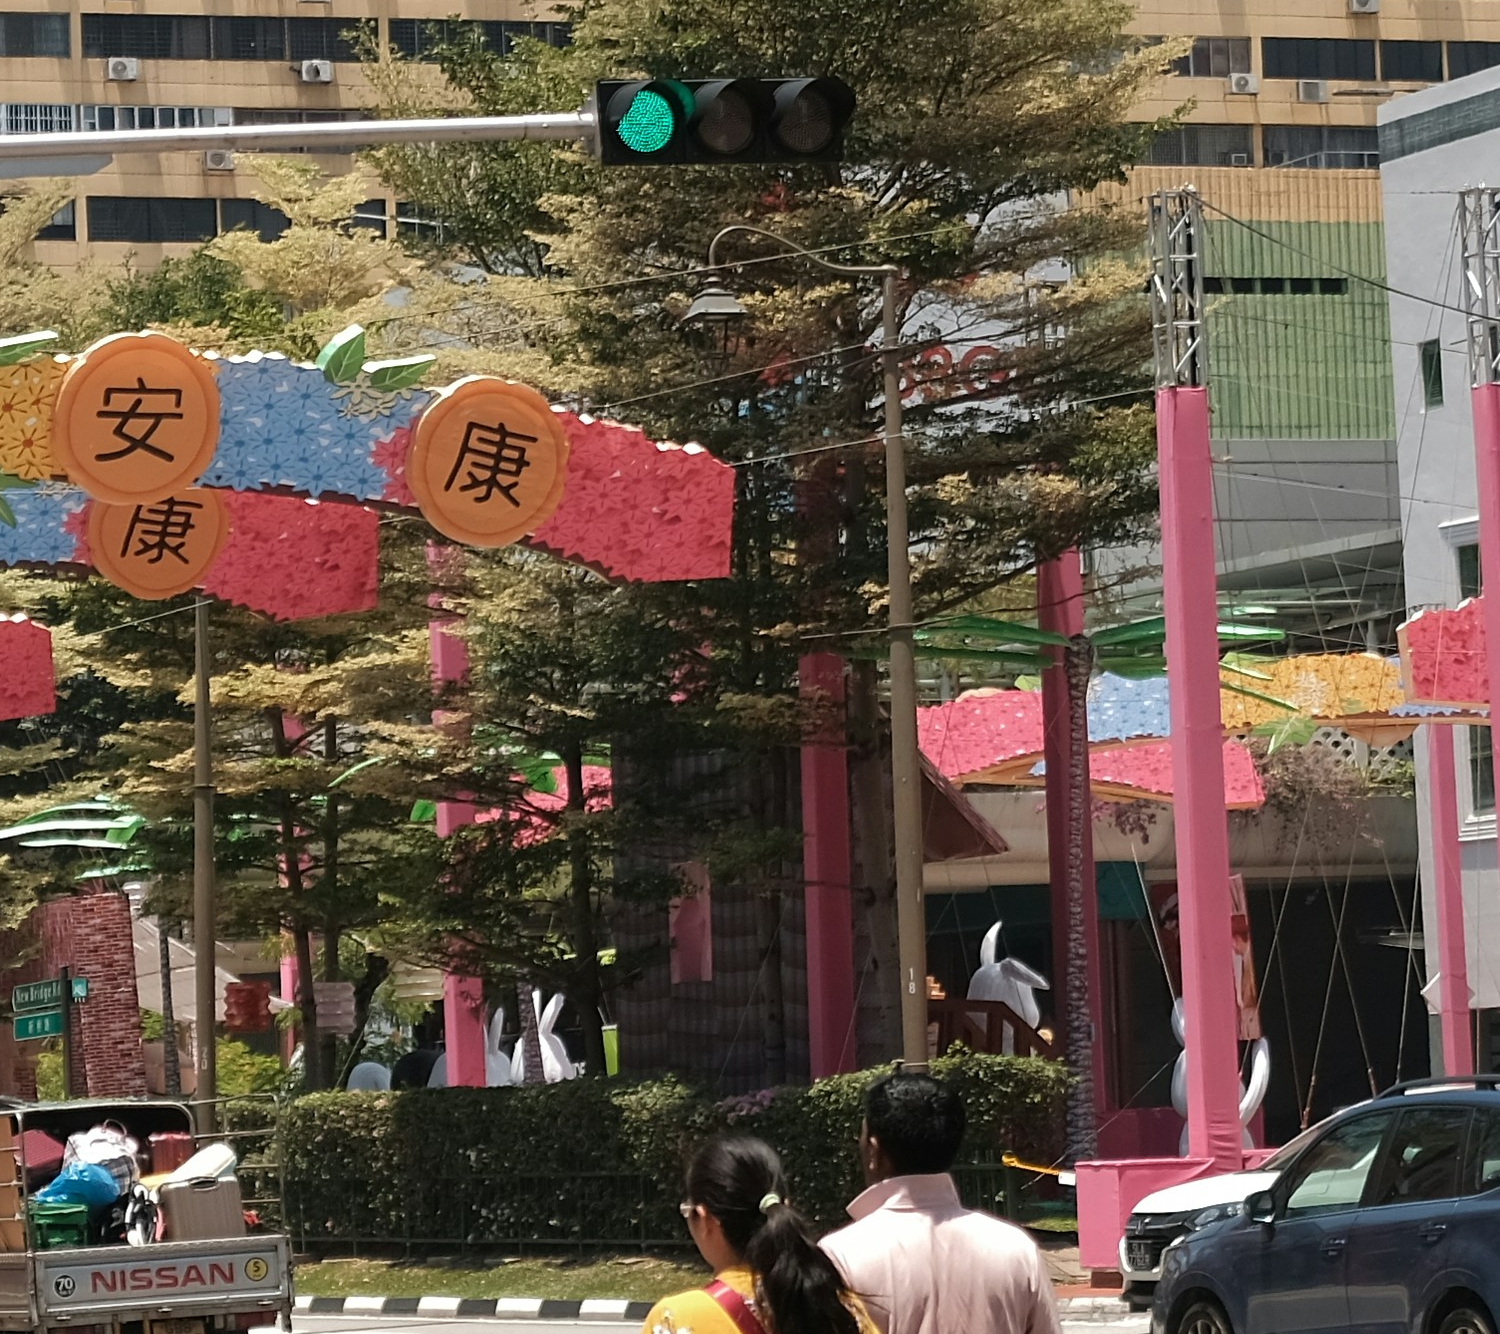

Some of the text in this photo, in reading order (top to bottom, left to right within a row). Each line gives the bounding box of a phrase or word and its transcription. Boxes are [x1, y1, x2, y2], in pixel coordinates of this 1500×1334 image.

[95, 377, 183, 462] 安
[444, 422, 538, 507] 康
[120, 496, 203, 564] 康
[91, 1262, 235, 1293] NISSAN
[252, 1262, 260, 1273] 5
[57, 1278, 73, 1291] 70
